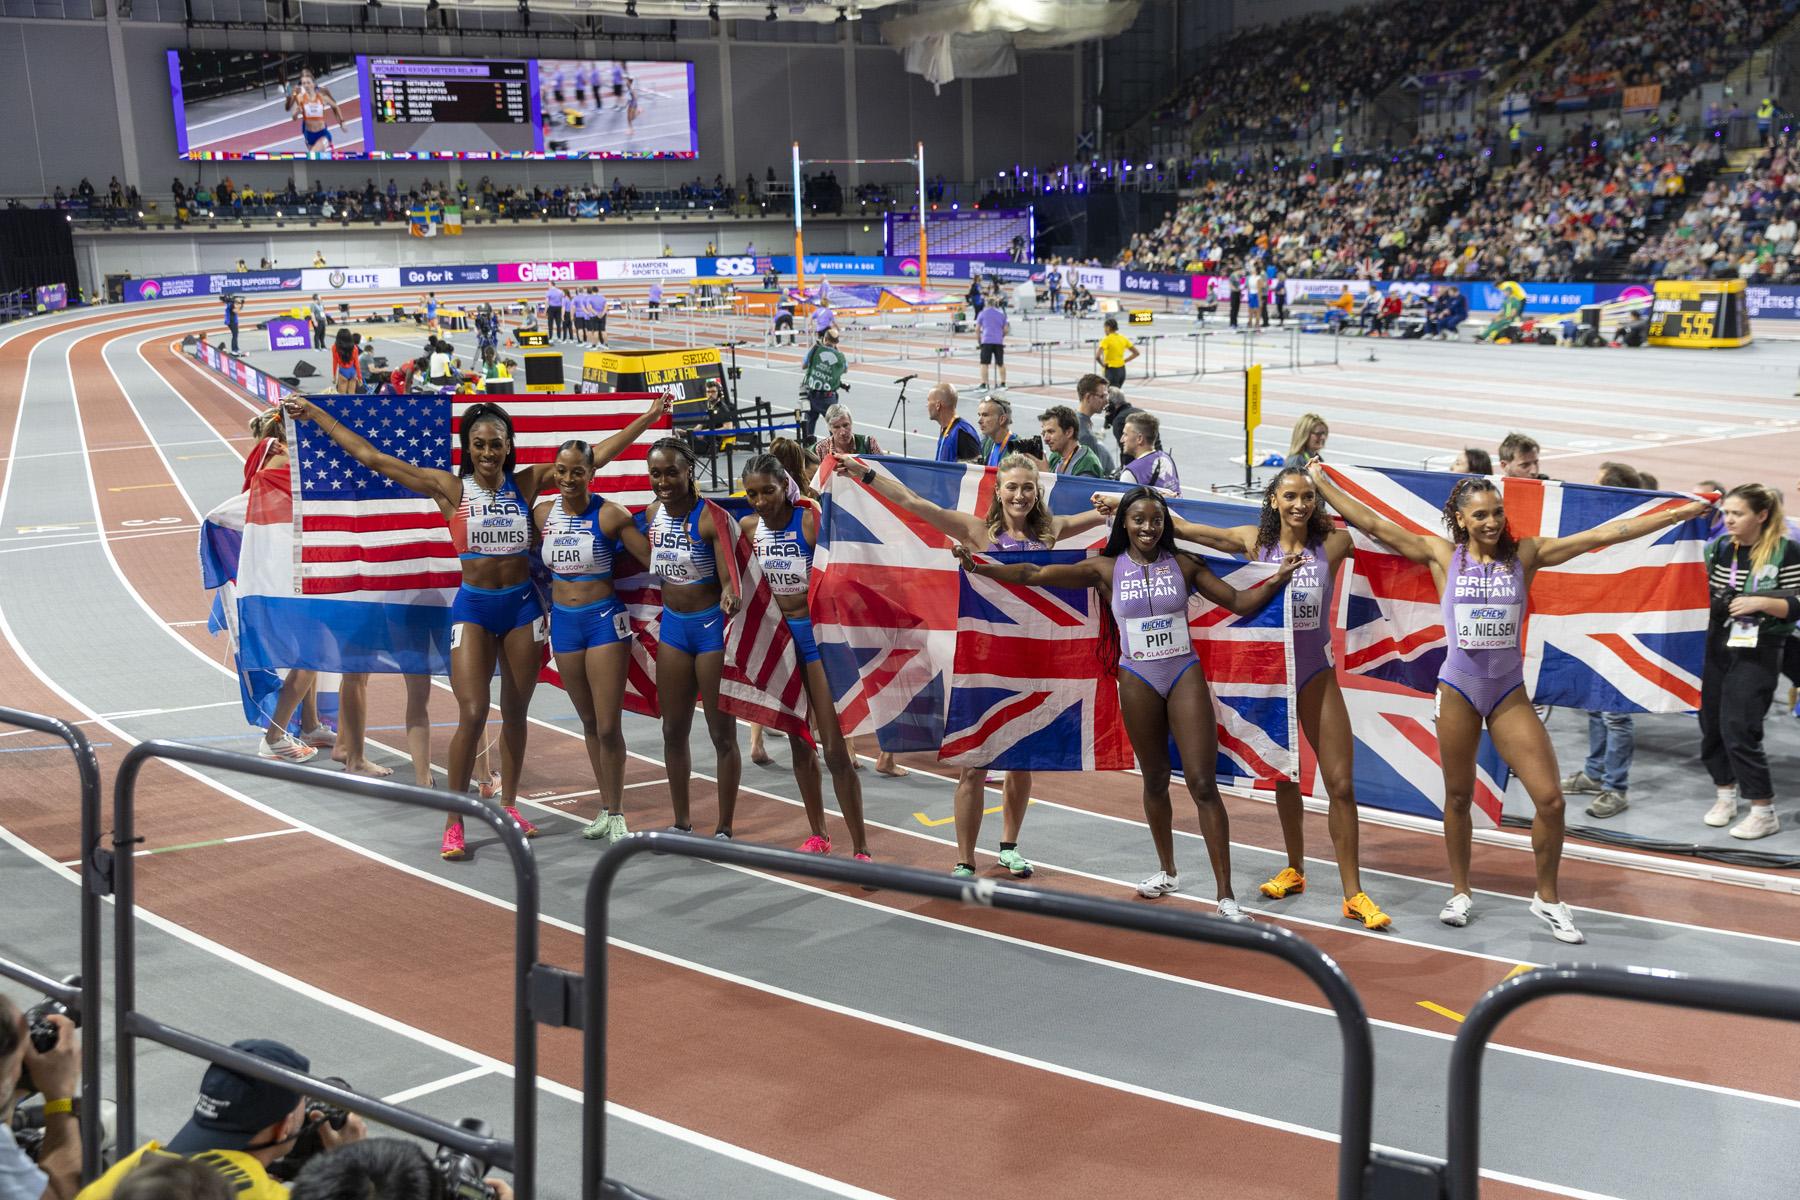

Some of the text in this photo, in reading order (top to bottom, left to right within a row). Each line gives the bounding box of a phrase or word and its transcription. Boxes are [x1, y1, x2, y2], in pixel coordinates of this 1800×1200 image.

[518, 263, 576, 281] Global
[716, 258, 755, 276] SOS
[348, 275, 379, 283] ELITE
[409, 271, 425, 282] Go
[426, 271, 443, 282] for
[445, 270, 453, 281] it
[1081, 274, 1104, 285] ELITE
[1126, 276, 1138, 289] Go
[1140, 276, 1151, 290] for
[1152, 278, 1159, 290] it
[682, 352, 715, 365] SEIKO
[645, 371, 662, 384] LONG
[663, 369, 678, 383] JUMP
[469, 503, 521, 517] USA
[121, 518, 182, 526] 3
[472, 531, 524, 543] HOLMES
[654, 532, 691, 551] USA
[552, 550, 580, 562] LEAR
[758, 543, 801, 557] USA
[655, 564, 687, 576] DIGGS
[1292, 566, 1317, 577] EAT
[1121, 576, 1173, 590] GREAT
[1292, 578, 1319, 587] TAIN
[1456, 575, 1513, 587] GREAT
[1121, 586, 1177, 600] BRITAIN
[1455, 587, 1516, 598] BRITAIN
[1294, 605, 1319, 618] LSEN
[620, 617, 627, 633] 4
[1476, 623, 1516, 636] NIELSEN
[1146, 632, 1172, 647] PIPI
[1147, 648, 1180, 657] GLASGOW
